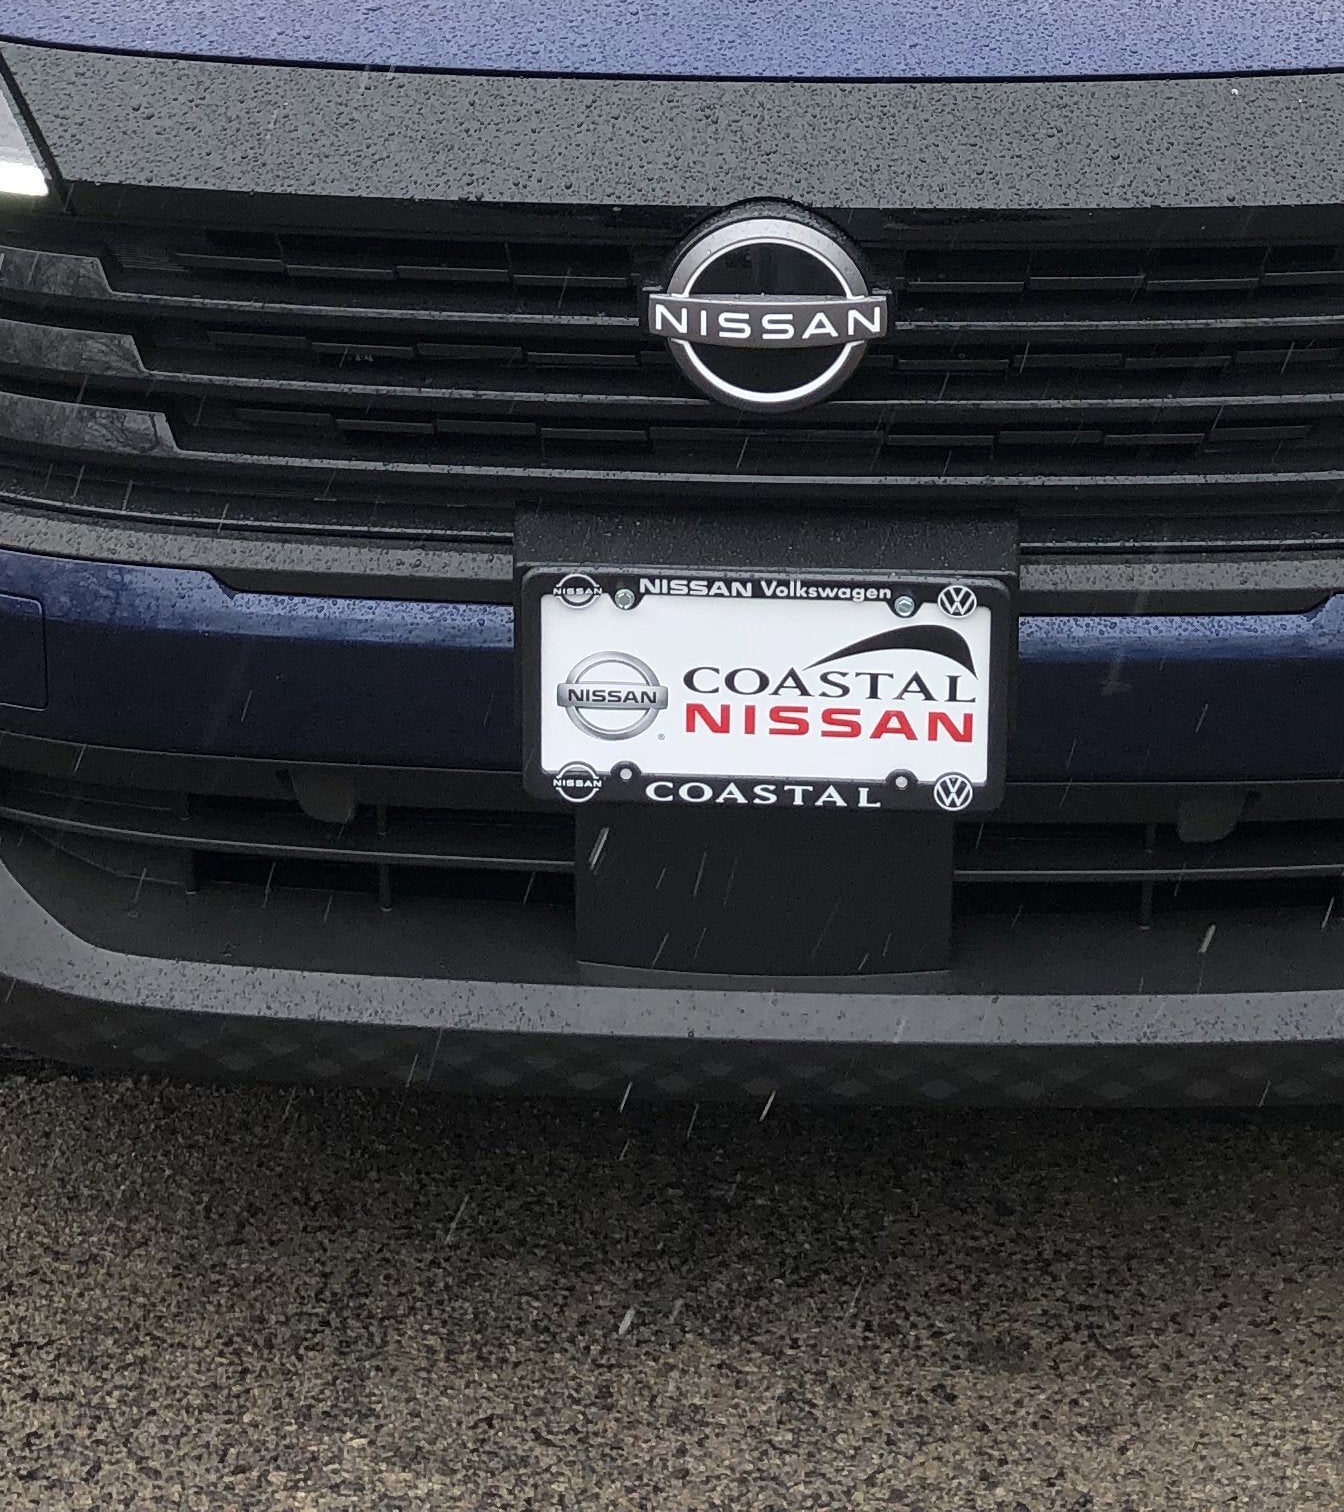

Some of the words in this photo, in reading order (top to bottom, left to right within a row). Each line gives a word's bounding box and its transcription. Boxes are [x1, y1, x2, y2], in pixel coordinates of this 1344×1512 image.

[655, 304, 880, 339] NISSAN
[553, 587, 602, 595] NISSAN
[639, 578, 752, 597] NISSAN
[761, 581, 891, 602] Volkswagen
[568, 688, 657, 704] NISSAN
[683, 666, 977, 703] COASTAL
[685, 703, 973, 743] NISSAN
[553, 779, 602, 788] NISSAN
[646, 781, 881, 808] COASTAL
